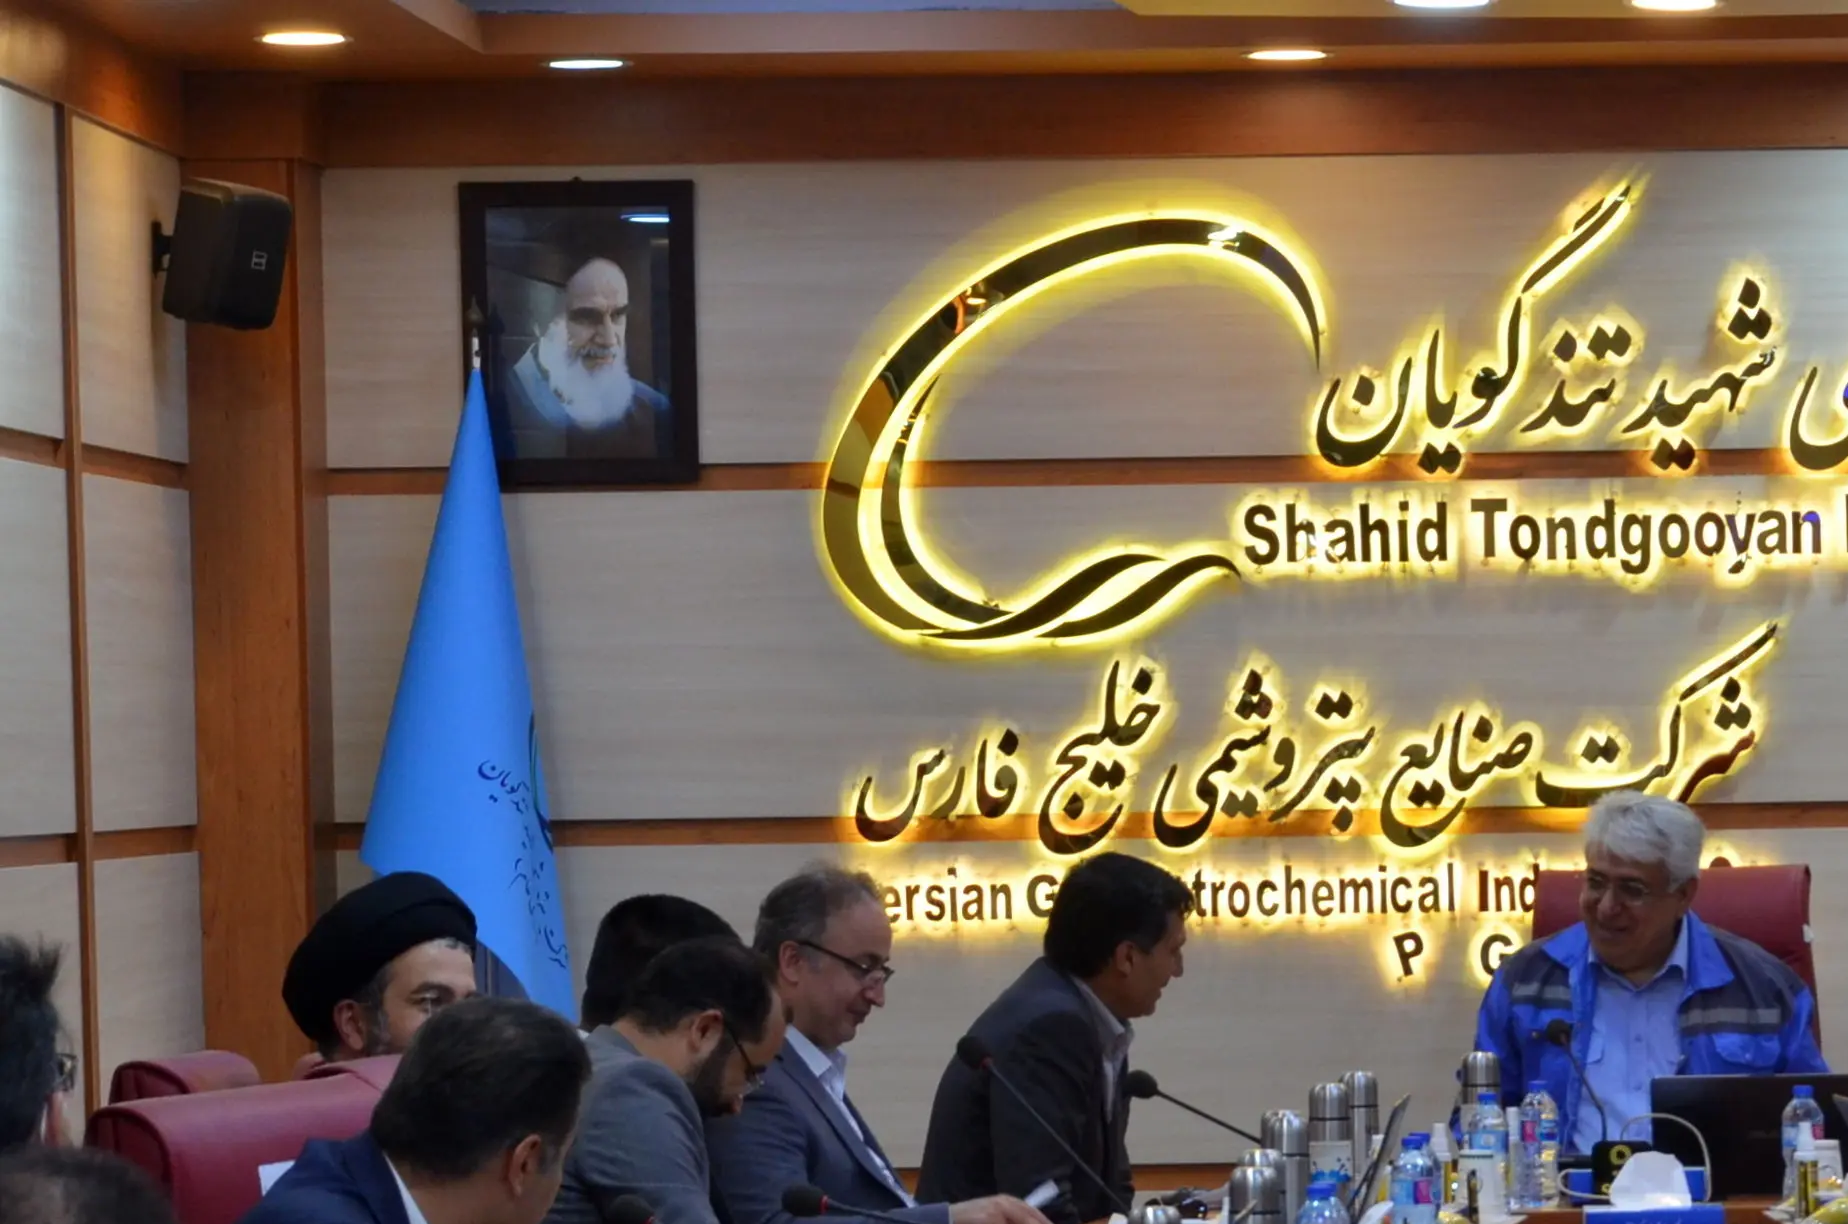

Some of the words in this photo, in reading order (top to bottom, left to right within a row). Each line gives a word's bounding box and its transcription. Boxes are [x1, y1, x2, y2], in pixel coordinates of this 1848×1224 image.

[1622, 277, 1777, 471] شهید
[1243, 500, 1449, 565] Shahid
[1470, 497, 1823, 576] Tondgooyan
[855, 728, 1020, 842] فارس
[1037, 658, 1163, 855] خلیج
[882, 866, 1014, 925] ersian
[1193, 861, 1456, 920] trochemical
